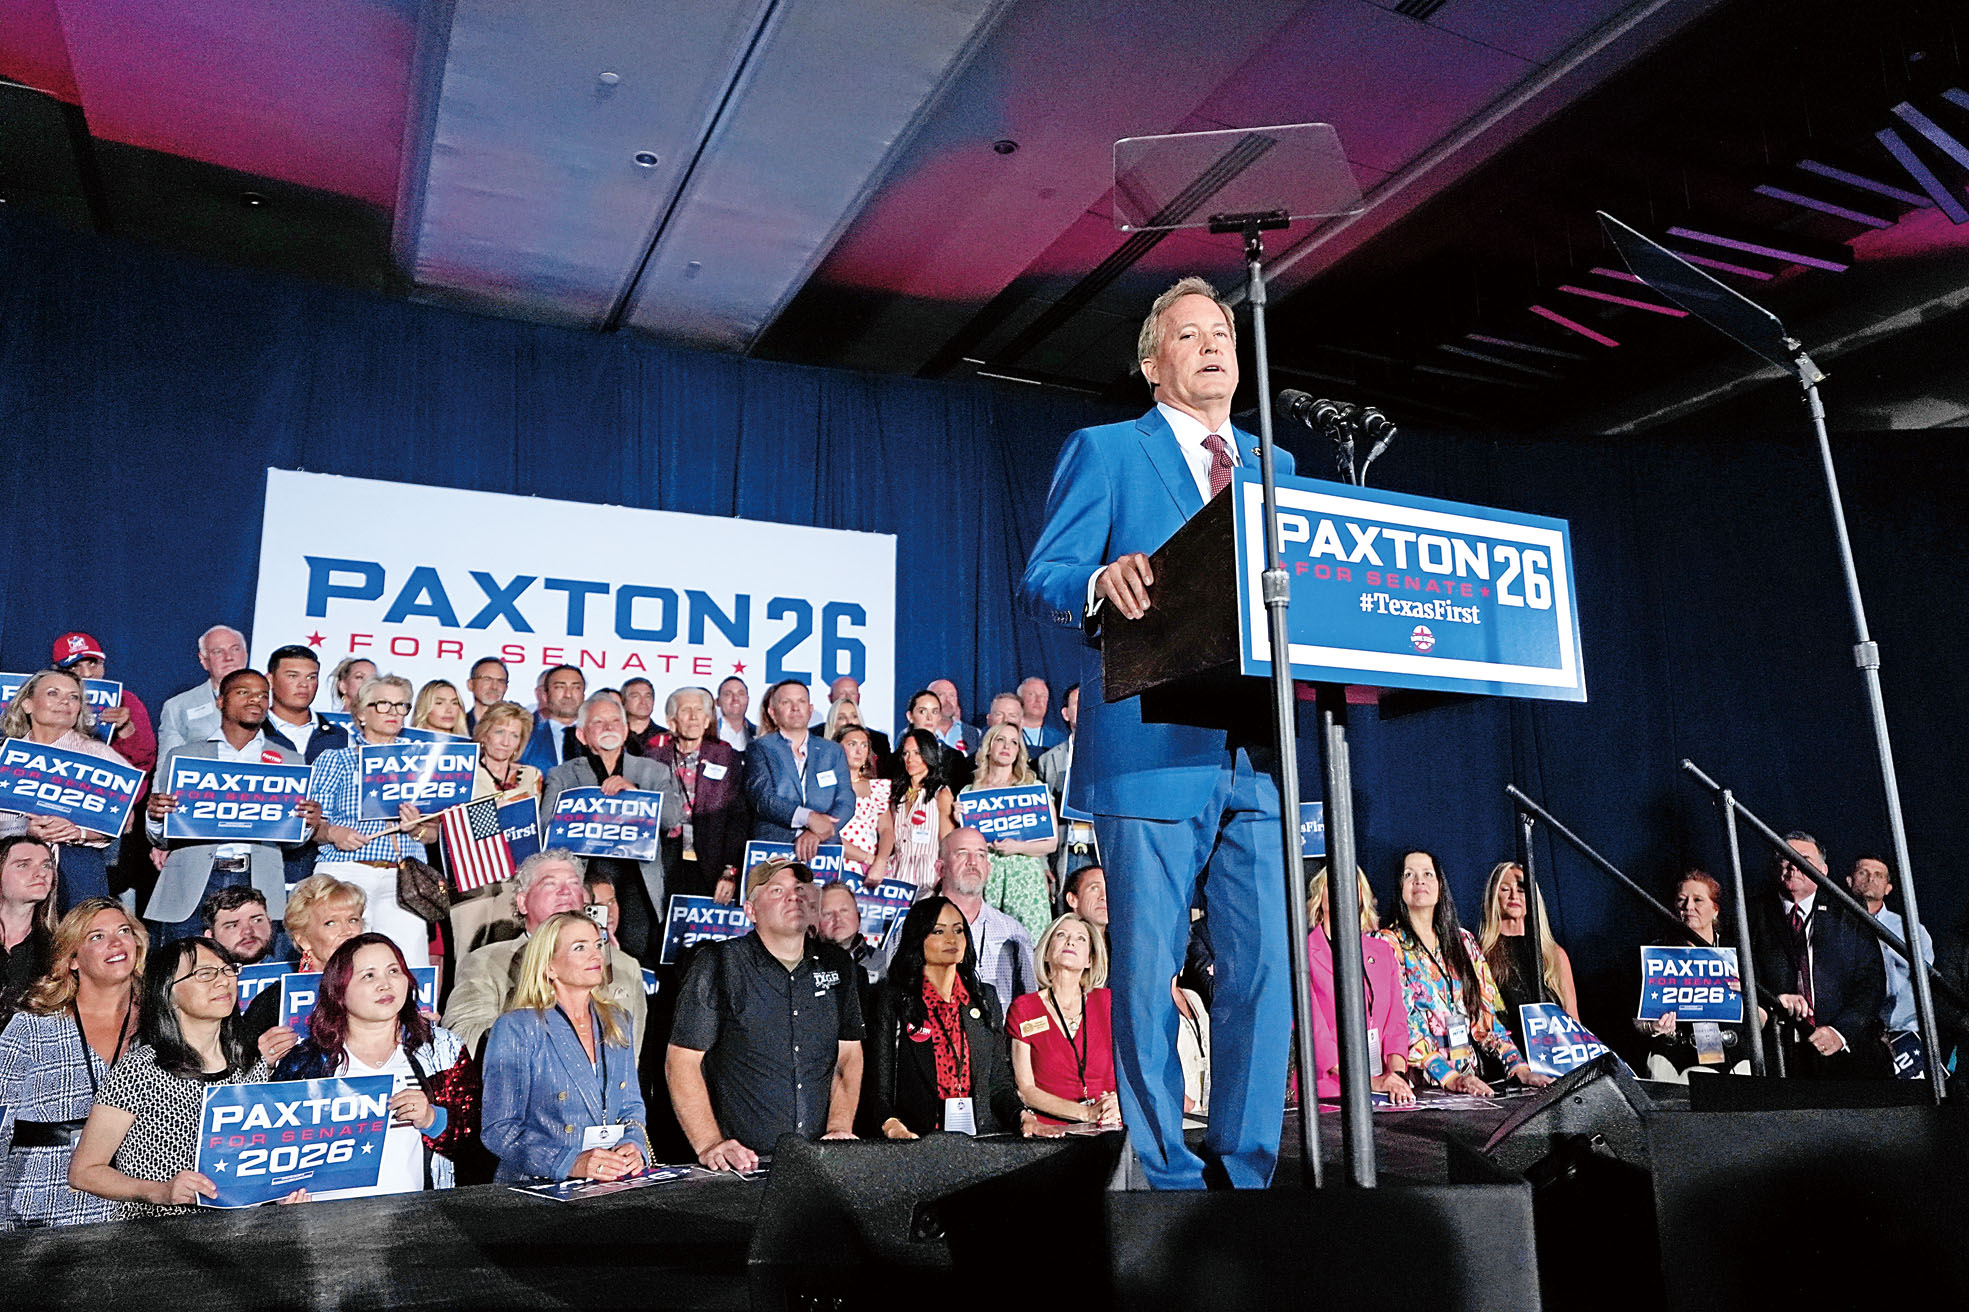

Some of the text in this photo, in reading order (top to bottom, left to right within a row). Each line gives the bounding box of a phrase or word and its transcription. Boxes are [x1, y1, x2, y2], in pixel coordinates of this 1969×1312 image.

[1276, 512, 1552, 610] PAXTON 26
[1295, 561, 1474, 598] FOR SENATE
[1359, 592, 1481, 624] #TexasFirst
[303, 555, 866, 688] PAXTON 26
[349, 633, 712, 675] FOR SENATE
[4, 750, 136, 794] PAXTON
[365, 755, 475, 774] PAXTON
[176, 770, 307, 794] PAXTON
[406, 773, 472, 782] SNATE
[13, 779, 106, 814] 2026
[51, 776, 130, 803] SENATE
[175, 790, 305, 803] FOR SENATE
[382, 782, 455, 800] 2026
[193, 801, 284, 822] 2026
[556, 798, 658, 818] PAXTON
[962, 793, 1048, 814] PAXTON
[566, 823, 639, 842] 2026
[978, 814, 1038, 832] 2026
[750, 850, 840, 871] PAON
[845, 878, 914, 901] AXTON
[857, 903, 897, 920] 026
[683, 932, 738, 948] 22
[1646, 959, 1739, 977] PAXTON
[1648, 978, 1676, 986] FOR
[1662, 987, 1725, 1004] 2026
[1527, 1015, 1594, 1037] PAXT
[211, 1093, 389, 1133] PAXTON
[209, 1120, 384, 1149] FOR SENATE
[236, 1138, 357, 1177] 2026
